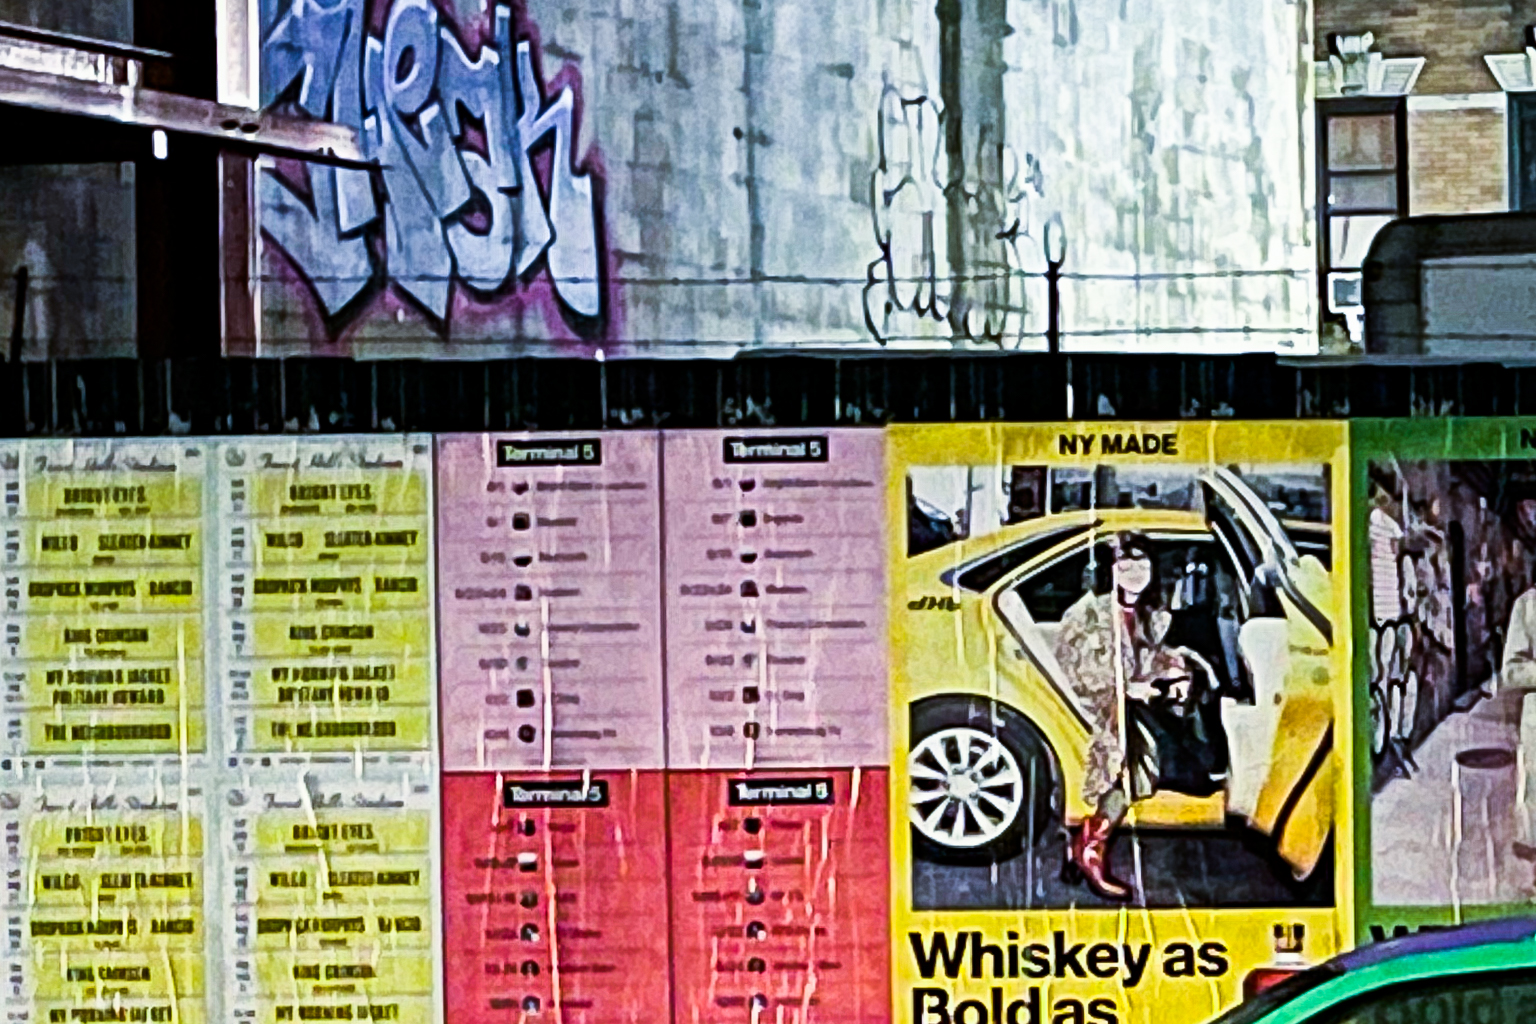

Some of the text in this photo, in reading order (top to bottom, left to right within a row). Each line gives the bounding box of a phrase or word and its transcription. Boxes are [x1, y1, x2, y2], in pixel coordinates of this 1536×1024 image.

[1058, 433, 1178, 454] NY MADE
[909, 930, 1228, 987] Whiskey as
